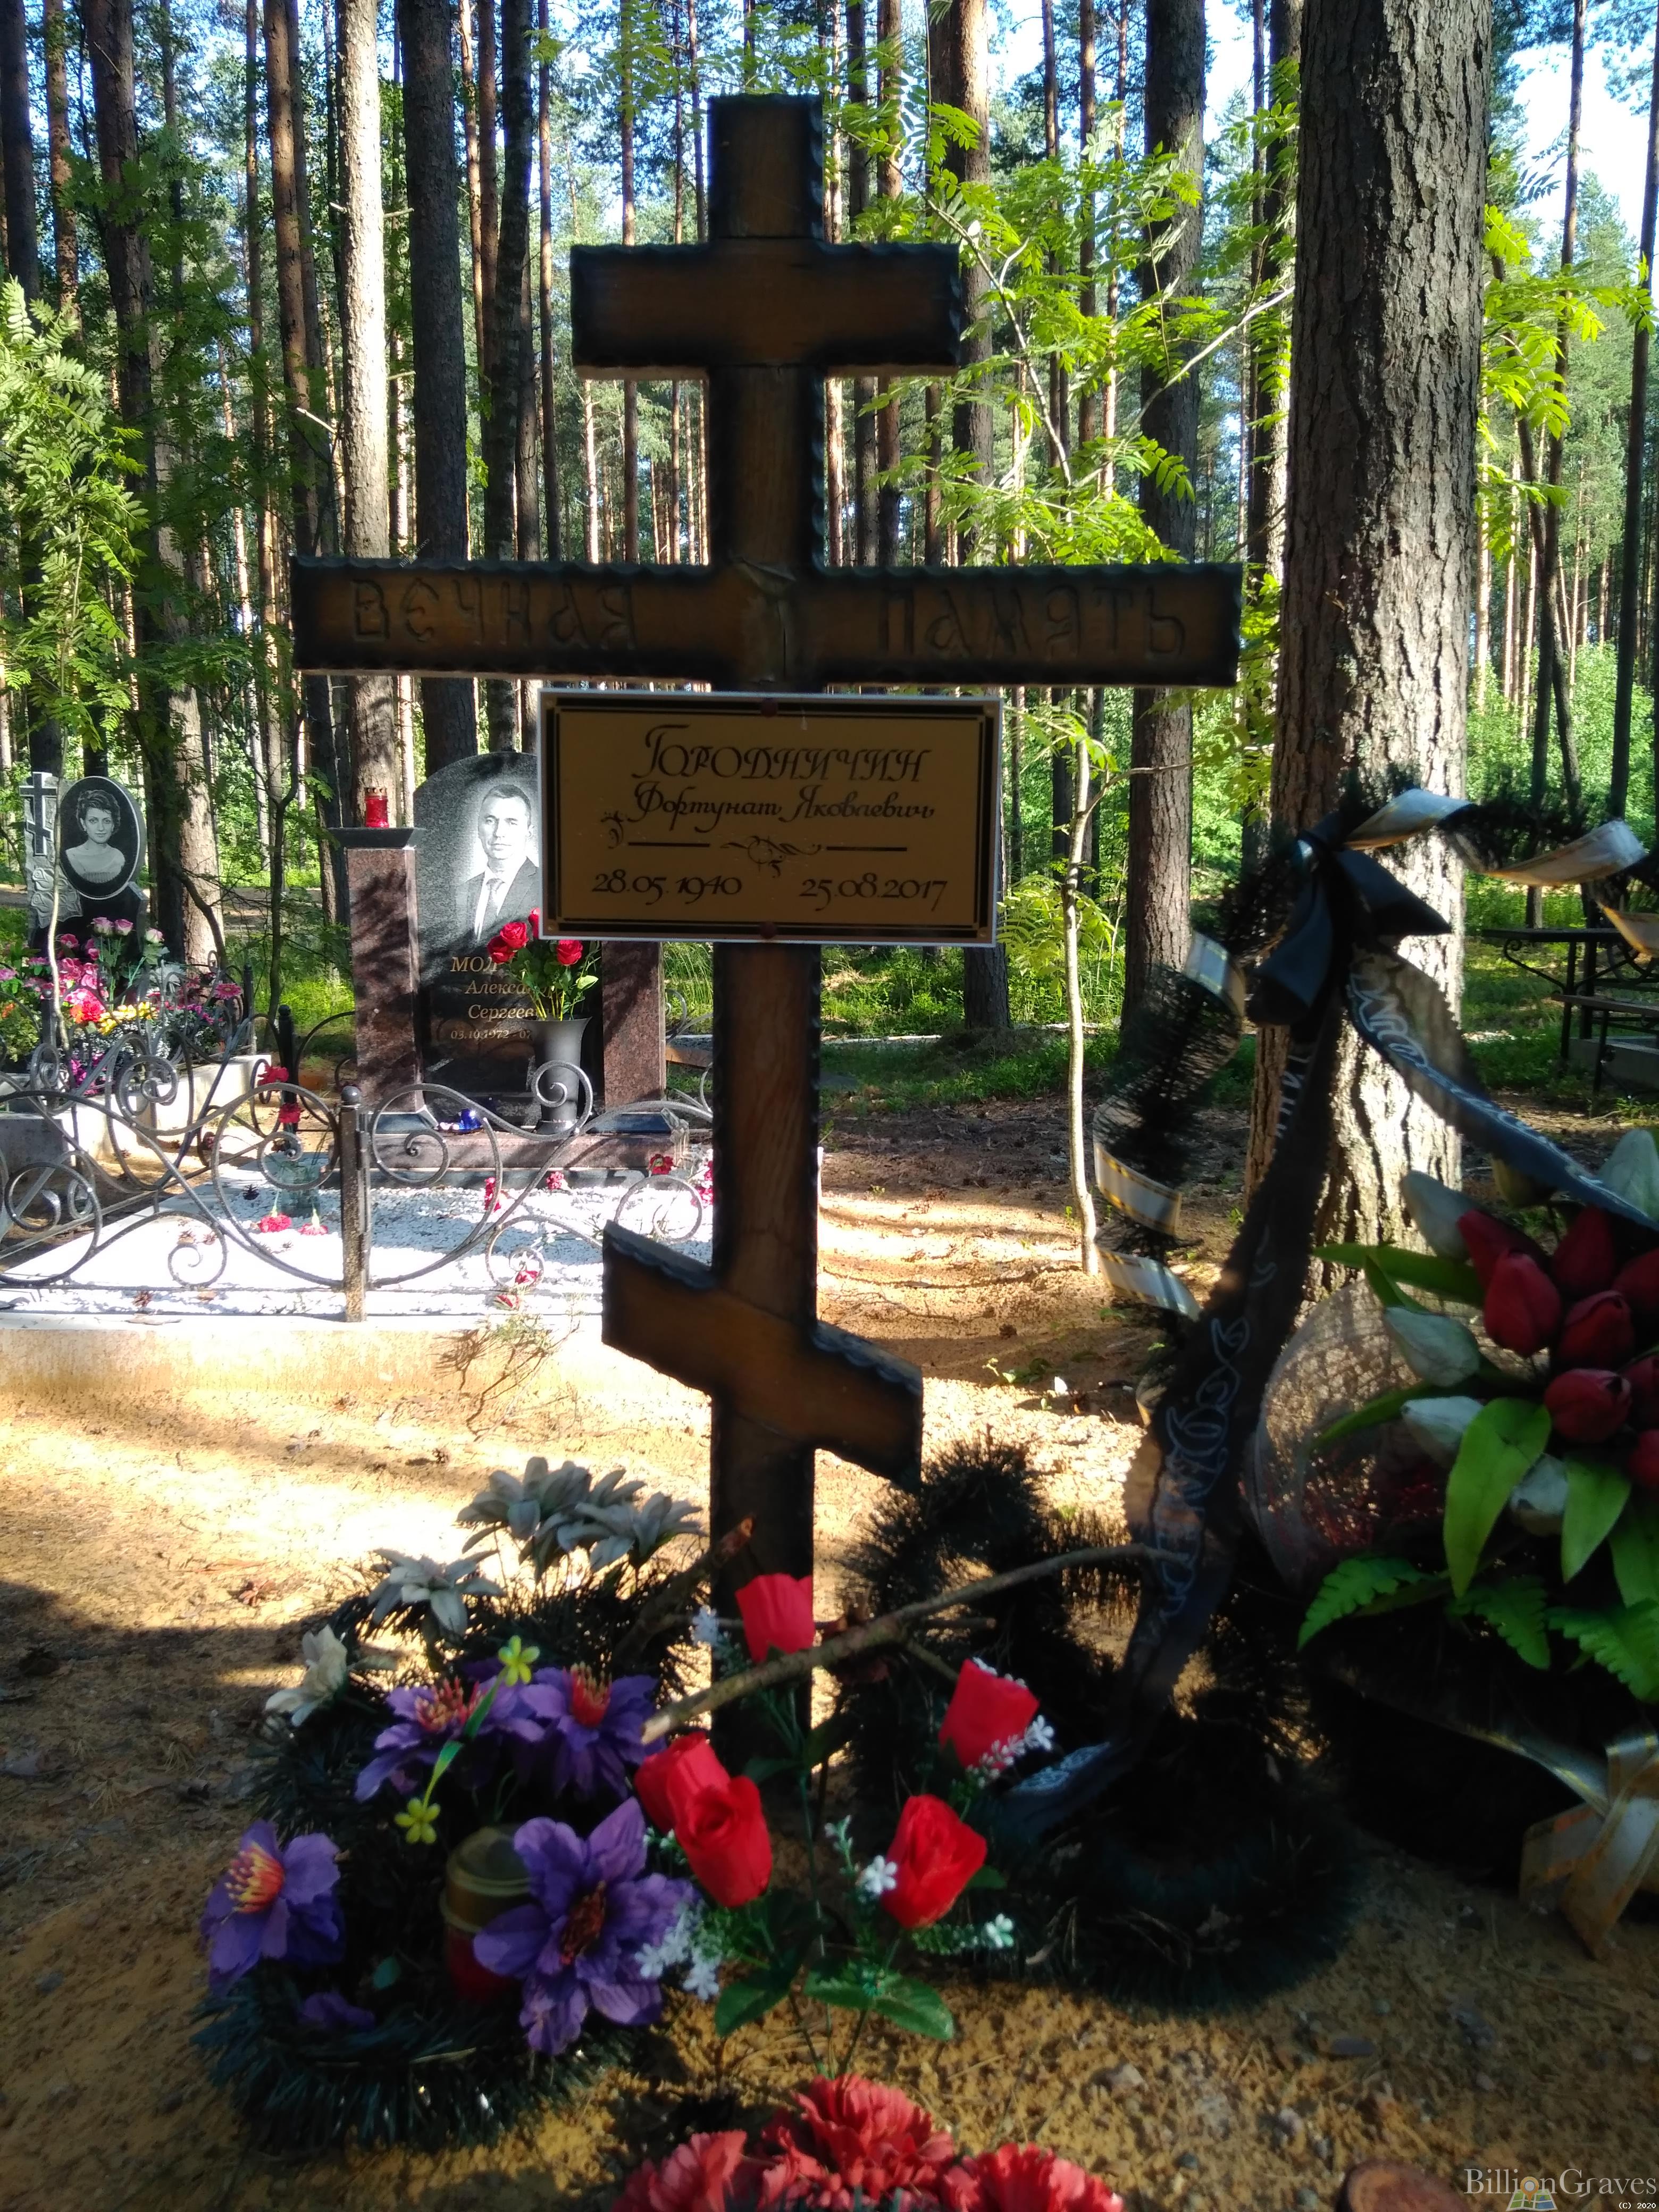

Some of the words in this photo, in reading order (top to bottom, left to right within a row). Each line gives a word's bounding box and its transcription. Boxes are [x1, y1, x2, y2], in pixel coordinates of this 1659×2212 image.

[632, 725, 932, 782] ГОРОДНИЧИН
[627, 781, 782, 833] Фортунат
[778, 785, 935, 823] Яковлевич
[799, 872, 948, 911] 25.08.2017
